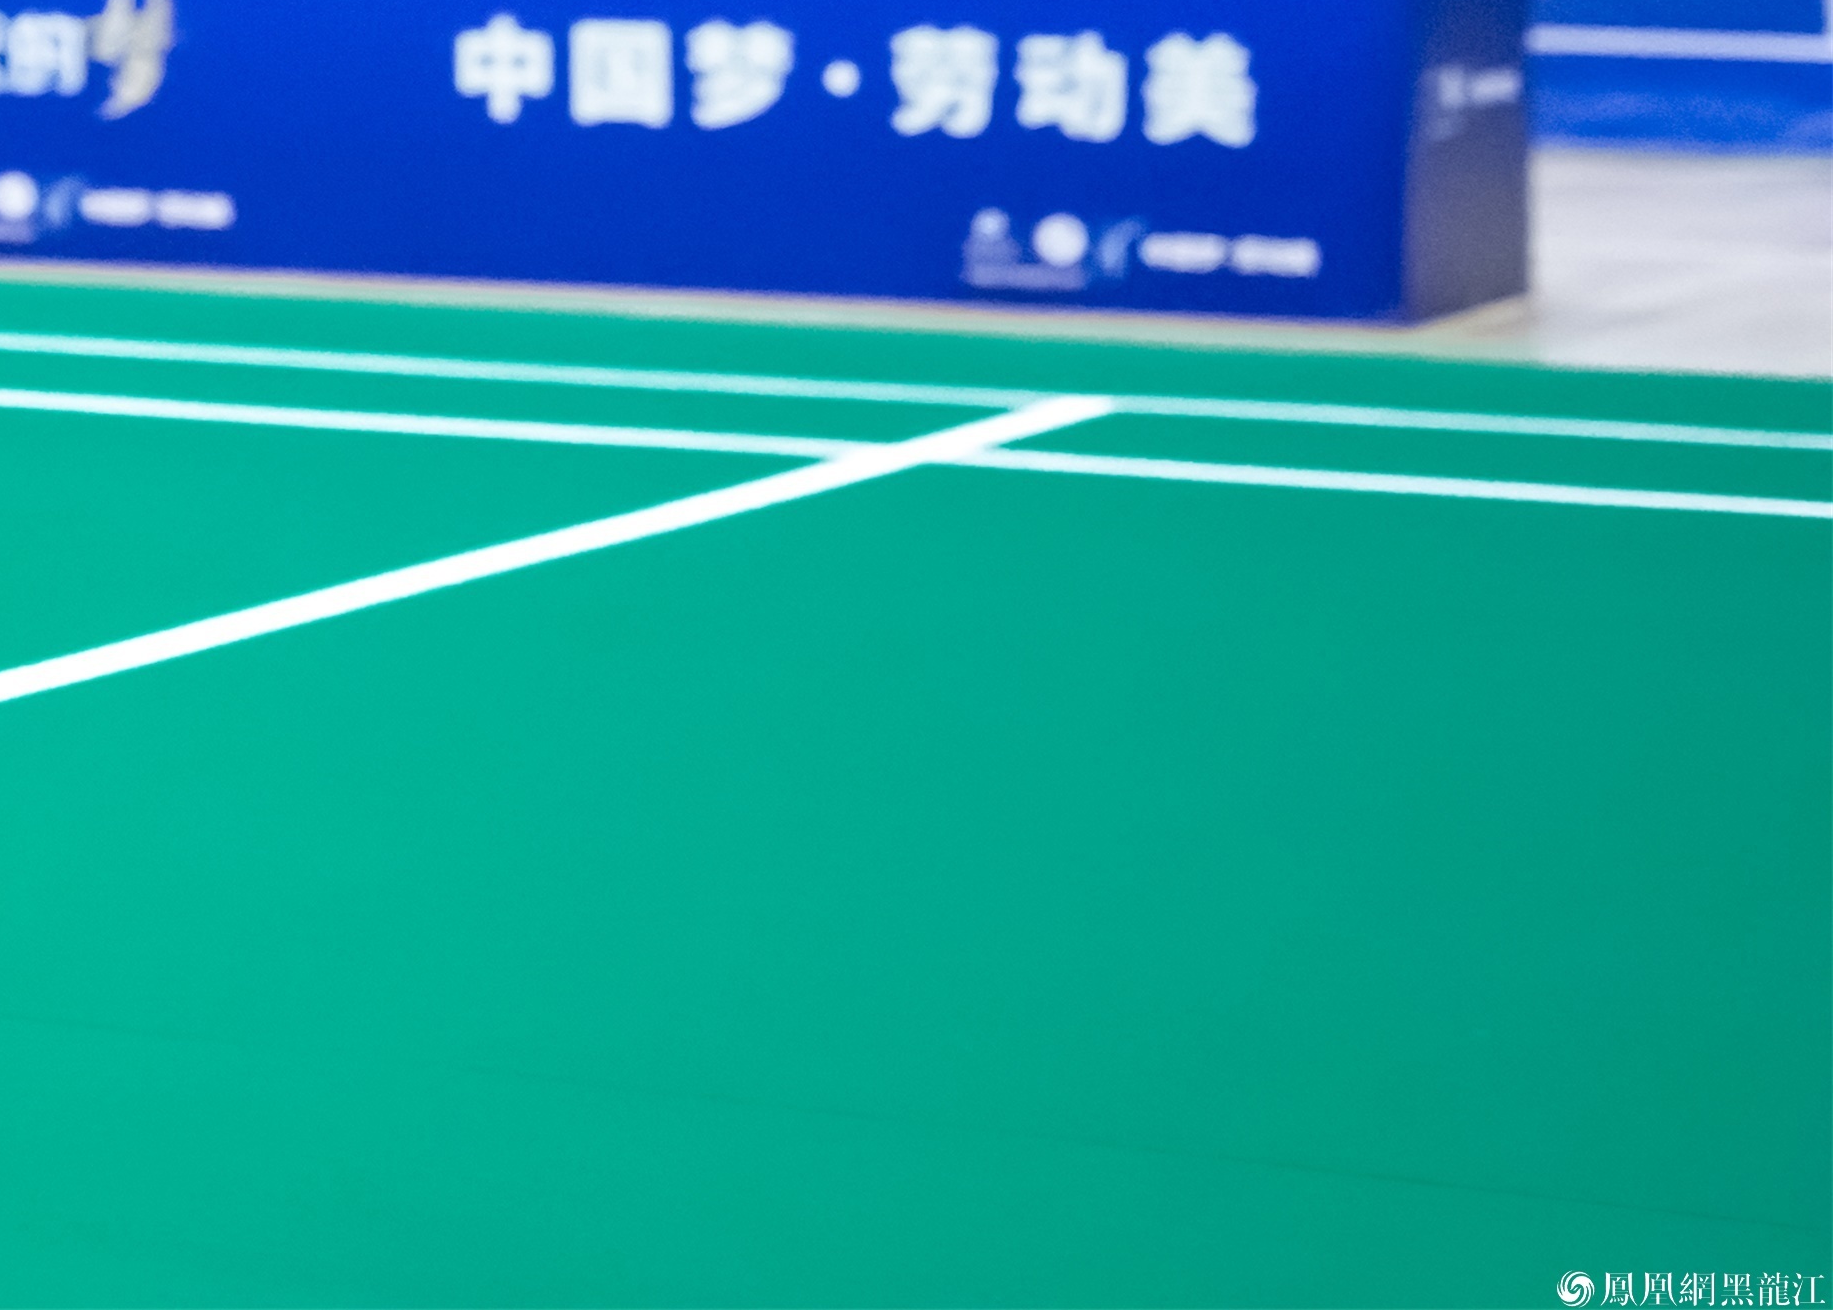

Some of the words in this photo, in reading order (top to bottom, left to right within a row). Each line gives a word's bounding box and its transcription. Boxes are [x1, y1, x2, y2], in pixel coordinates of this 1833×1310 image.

[453, 14, 1257, 147] 中国梦·劳动美
